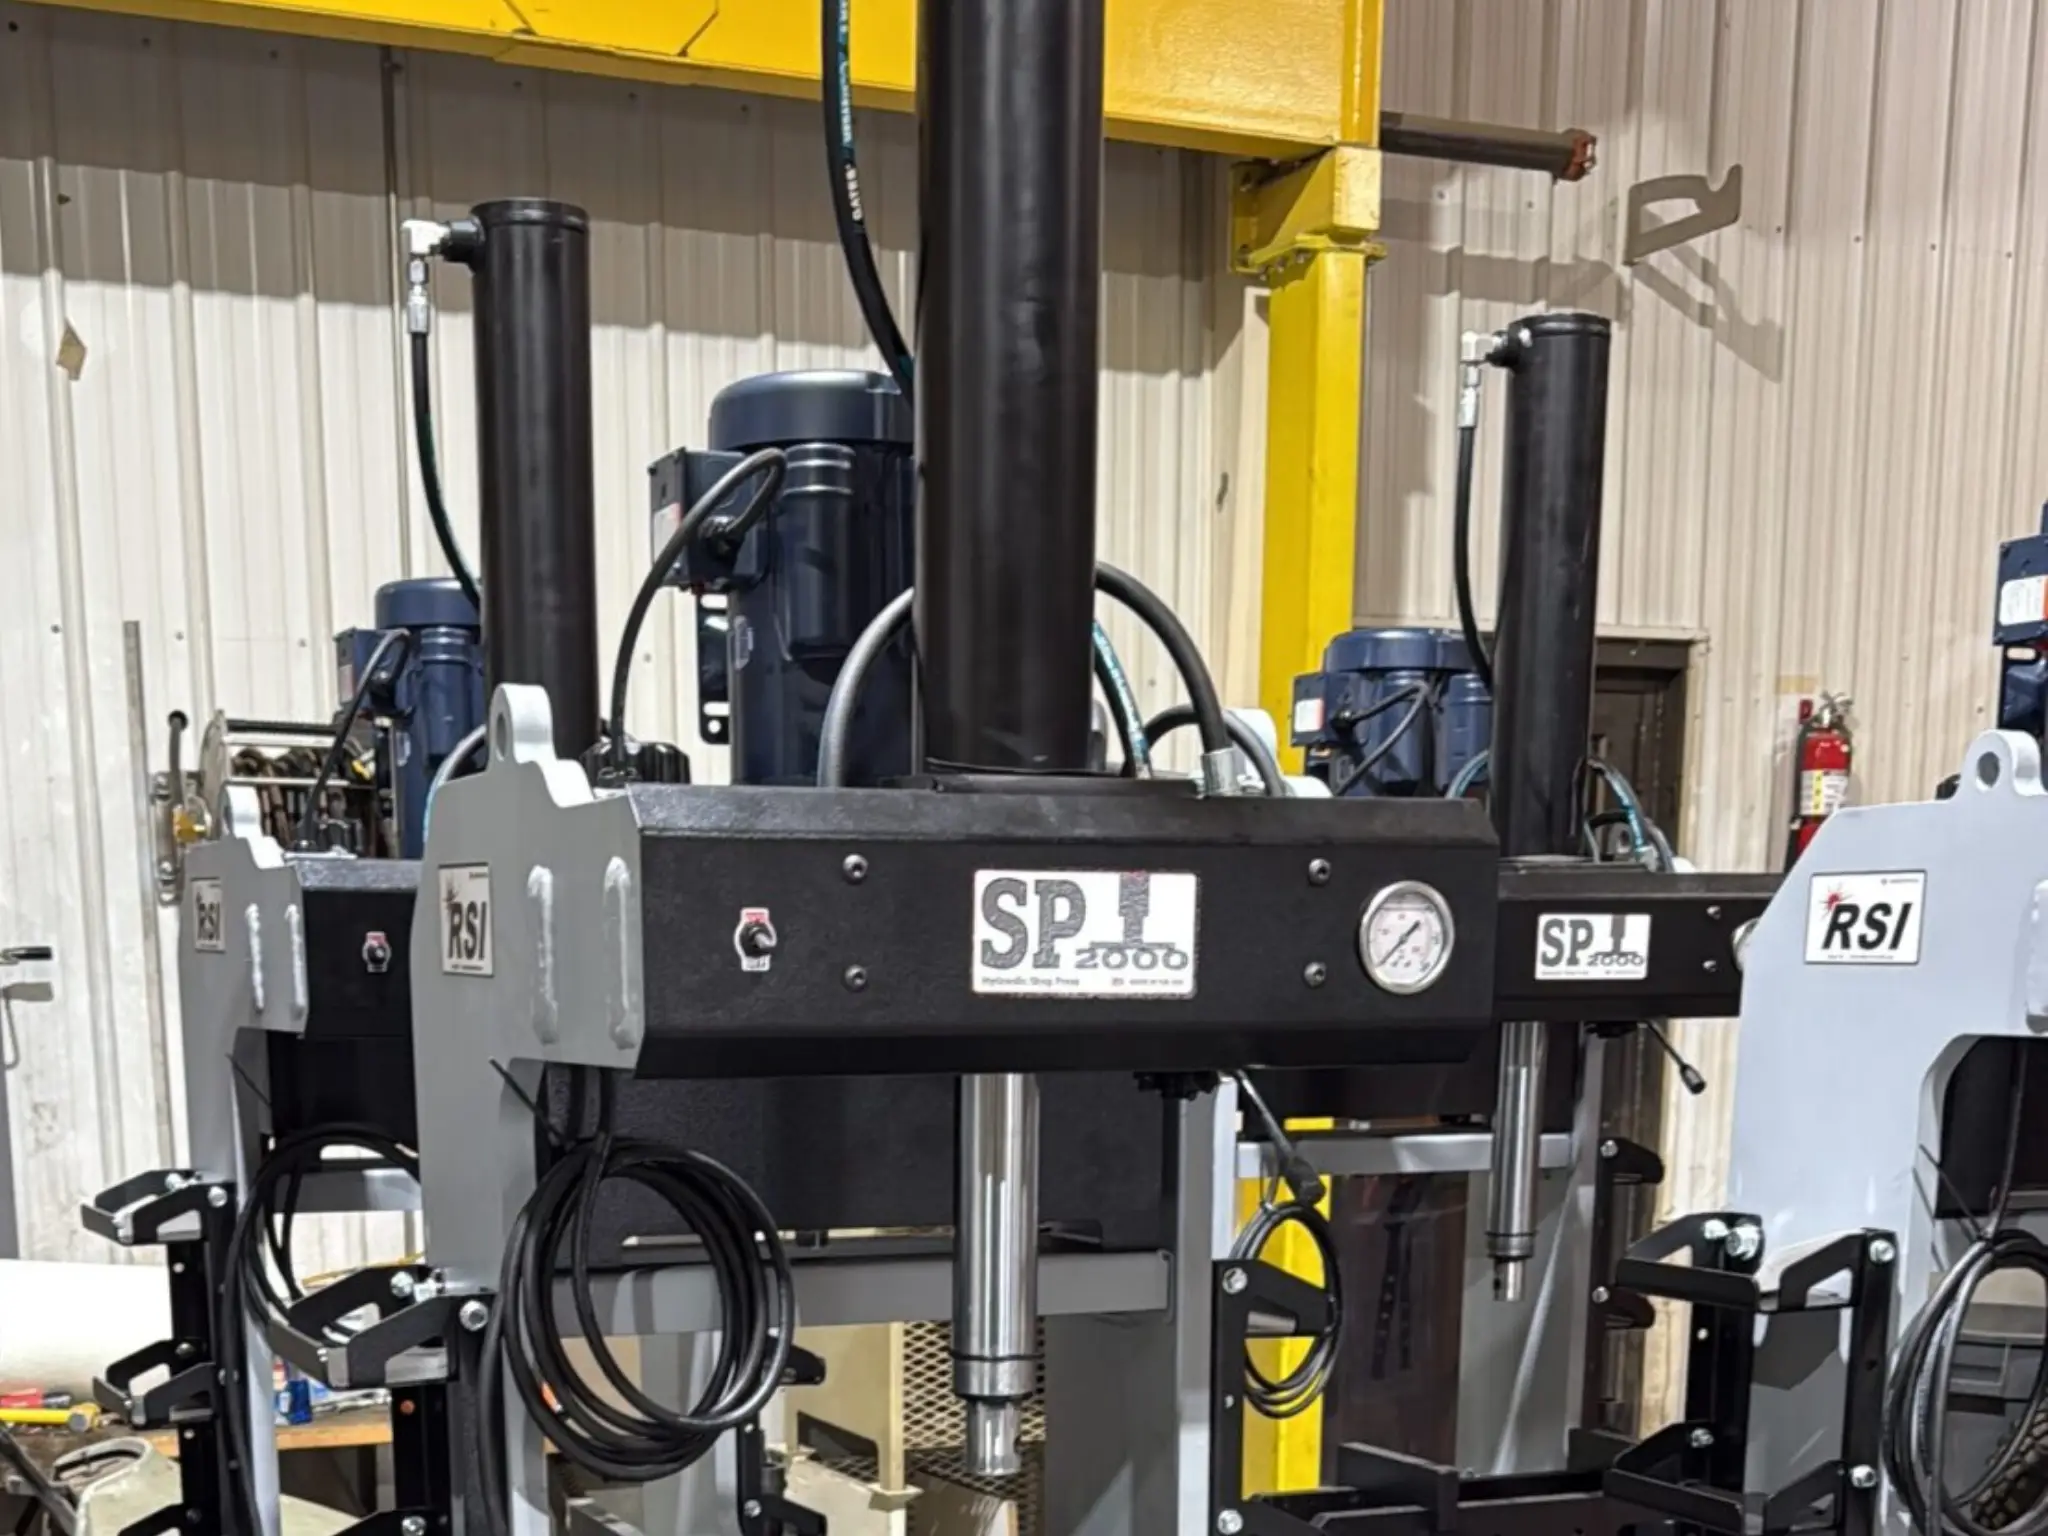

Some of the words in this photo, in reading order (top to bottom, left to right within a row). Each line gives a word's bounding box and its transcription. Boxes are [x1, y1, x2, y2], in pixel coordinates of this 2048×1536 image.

[446, 900, 488, 961] RSI
[981, 877, 1087, 969] SP
[1075, 948, 1189, 970] 2000
[1541, 918, 1594, 967] SP
[1586, 954, 1645, 967] 2000
[1821, 901, 1914, 950] RSI
